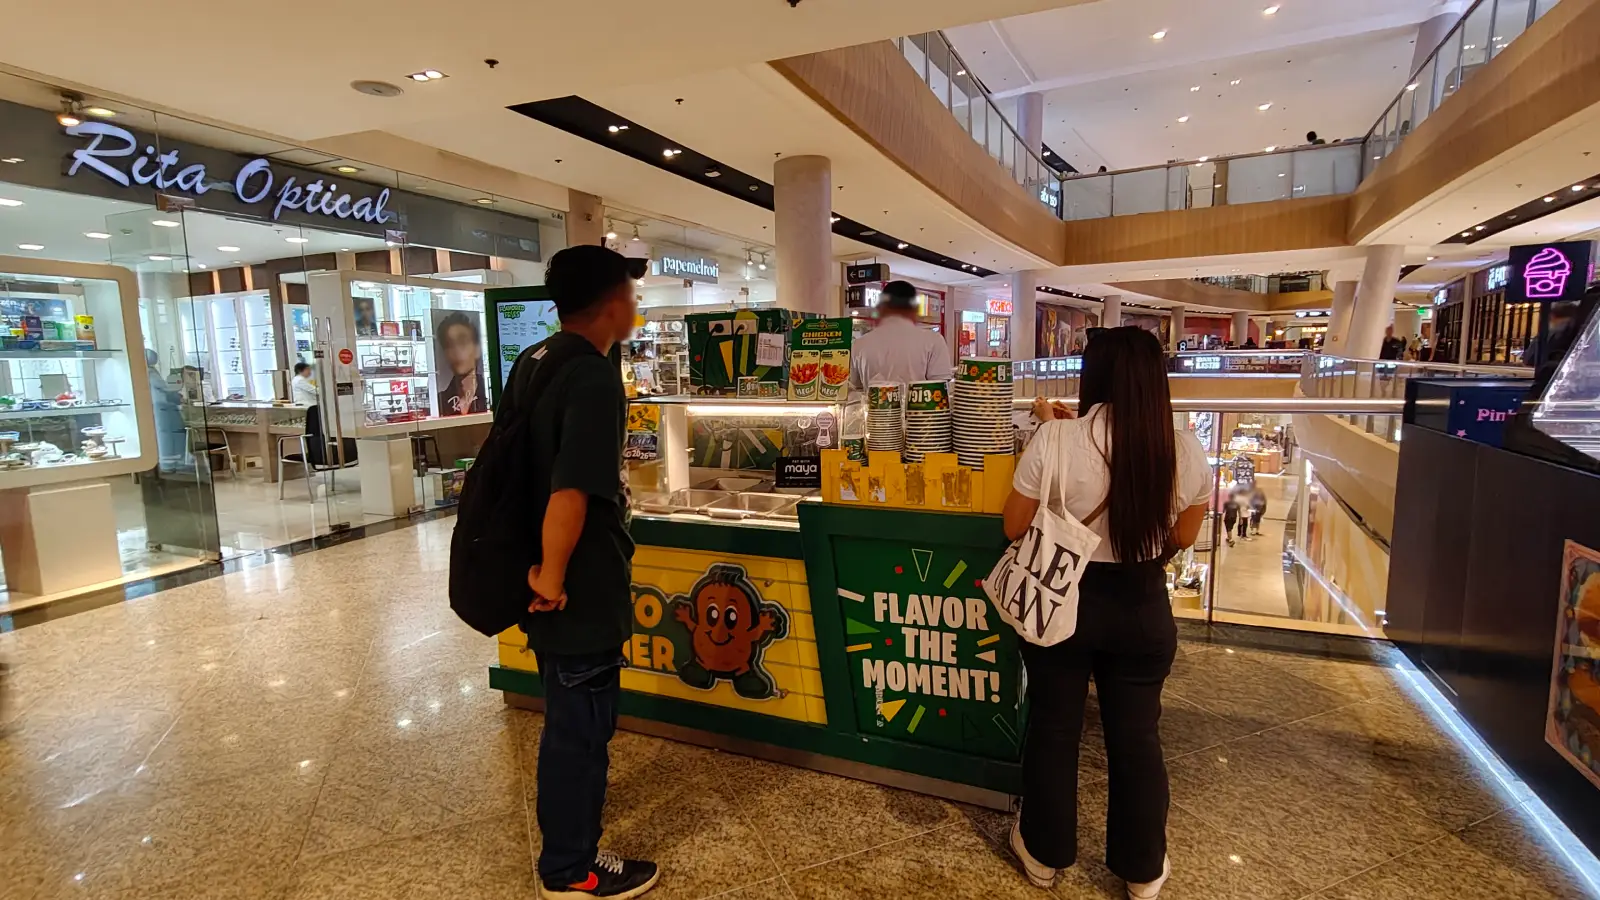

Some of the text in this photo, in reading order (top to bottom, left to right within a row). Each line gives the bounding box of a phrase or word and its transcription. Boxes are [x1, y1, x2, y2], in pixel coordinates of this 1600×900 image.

[66, 121, 392, 224] Rita Optical
[662, 256, 719, 278] papemelroti
[795, 386, 815, 396] MEGA
[784, 464, 818, 475] maya
[873, 591, 989, 631] FLAVOR
[901, 626, 958, 665] THE
[862, 658, 1001, 704] MOMENT!
